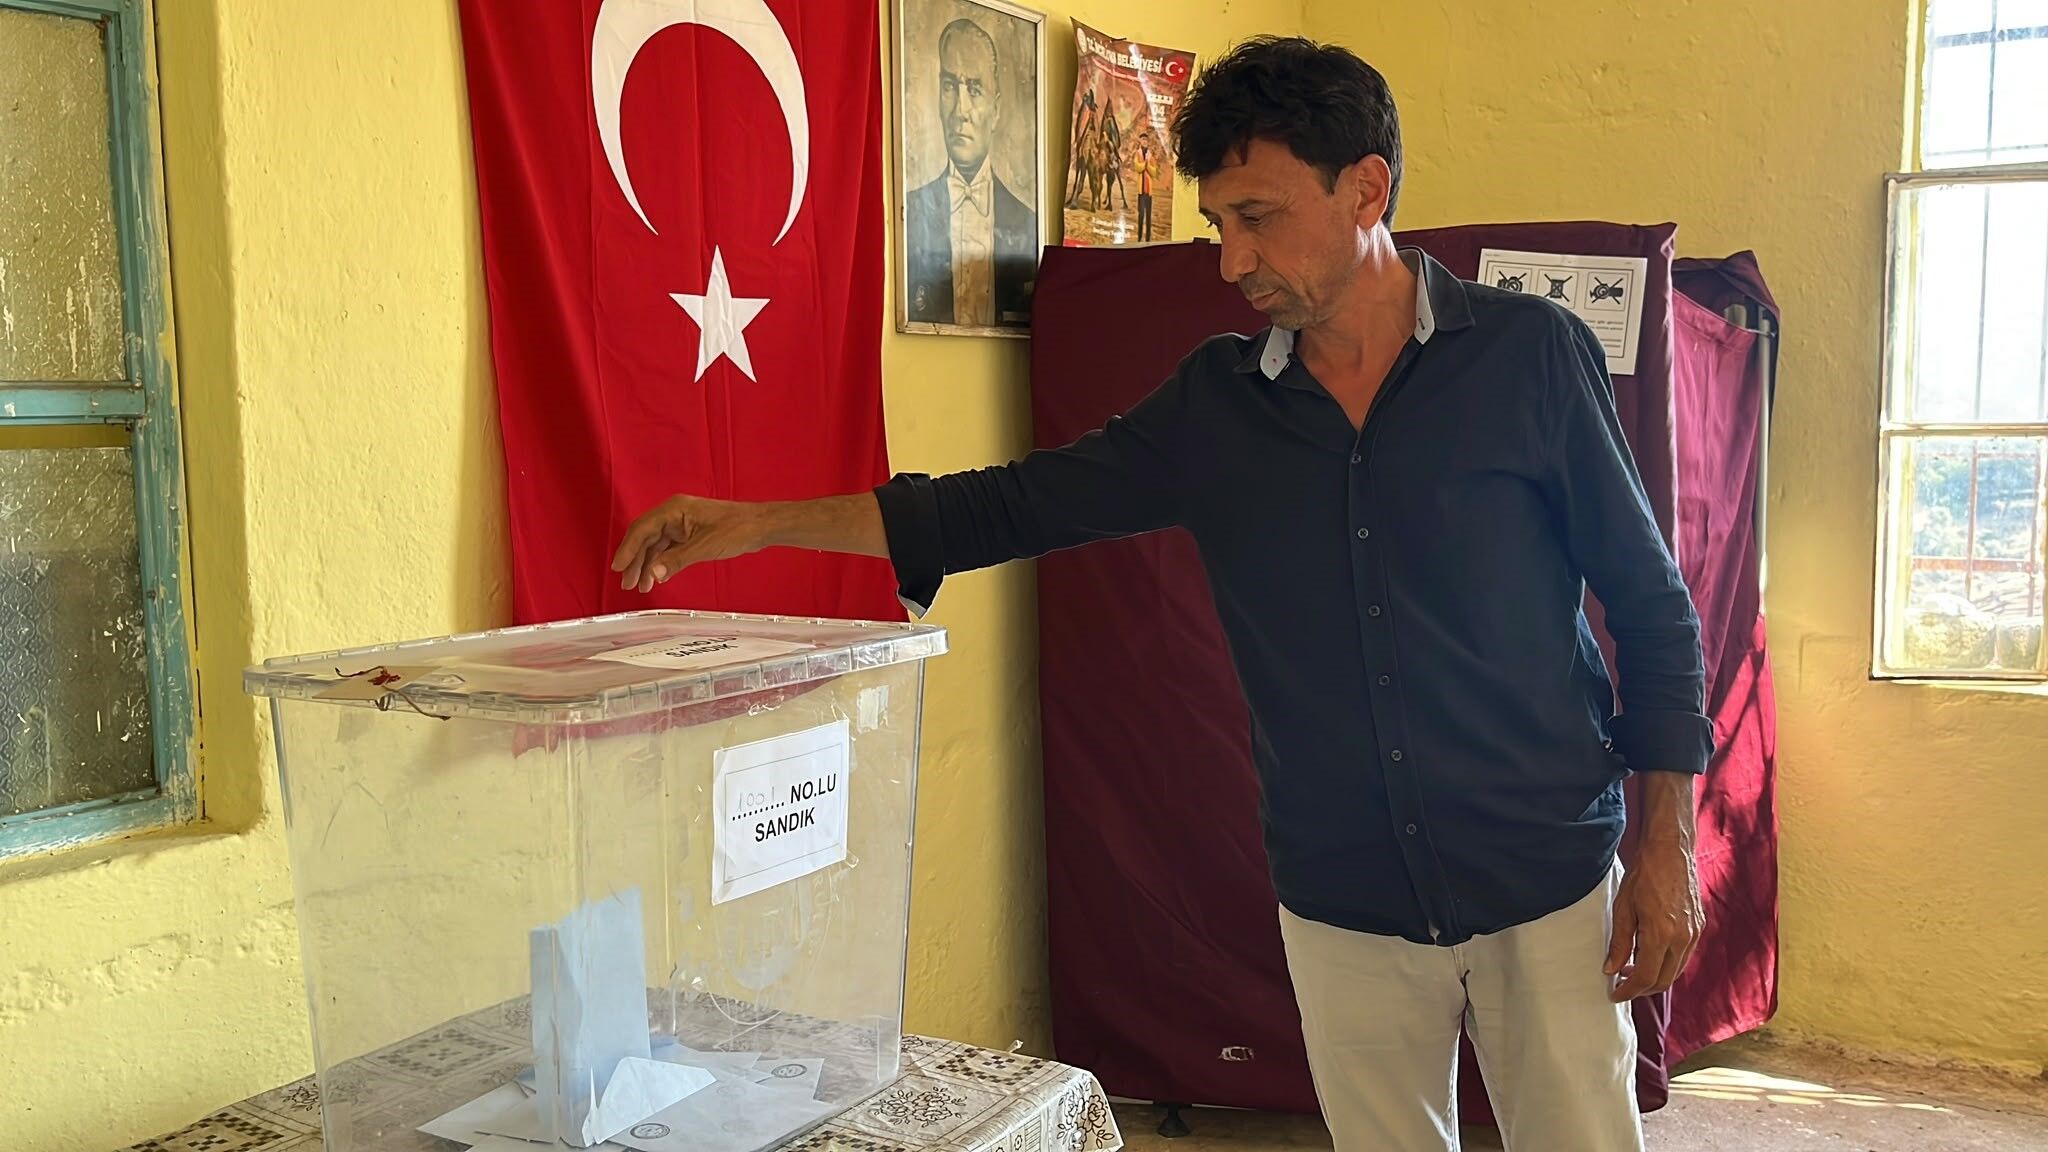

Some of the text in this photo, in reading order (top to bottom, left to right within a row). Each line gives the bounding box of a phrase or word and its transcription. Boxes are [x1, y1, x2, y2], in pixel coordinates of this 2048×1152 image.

[665, 643, 738, 657] SANDIK
[790, 773, 837, 804] NO.LU
[755, 807, 816, 843] SANDIK
